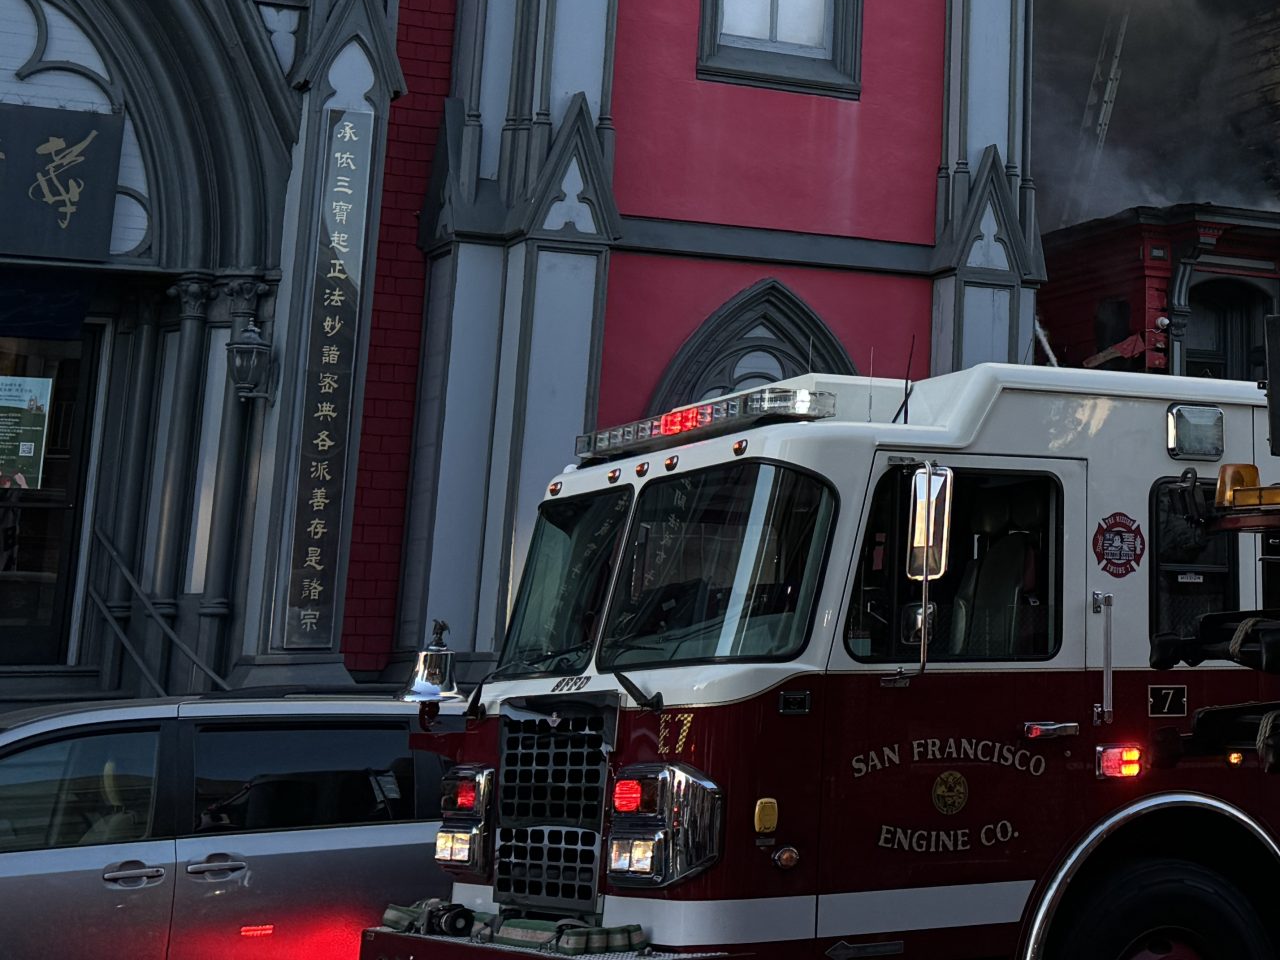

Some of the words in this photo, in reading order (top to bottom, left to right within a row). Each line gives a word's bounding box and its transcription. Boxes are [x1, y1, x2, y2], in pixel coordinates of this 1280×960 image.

[1161, 689, 1174, 713] 7
[658, 713, 694, 754] E7
[851, 744, 900, 778] SAN
[912, 738, 1046, 776] FRANCISCO
[878, 825, 970, 852] ENGINE
[980, 820, 1019, 846] CO.
